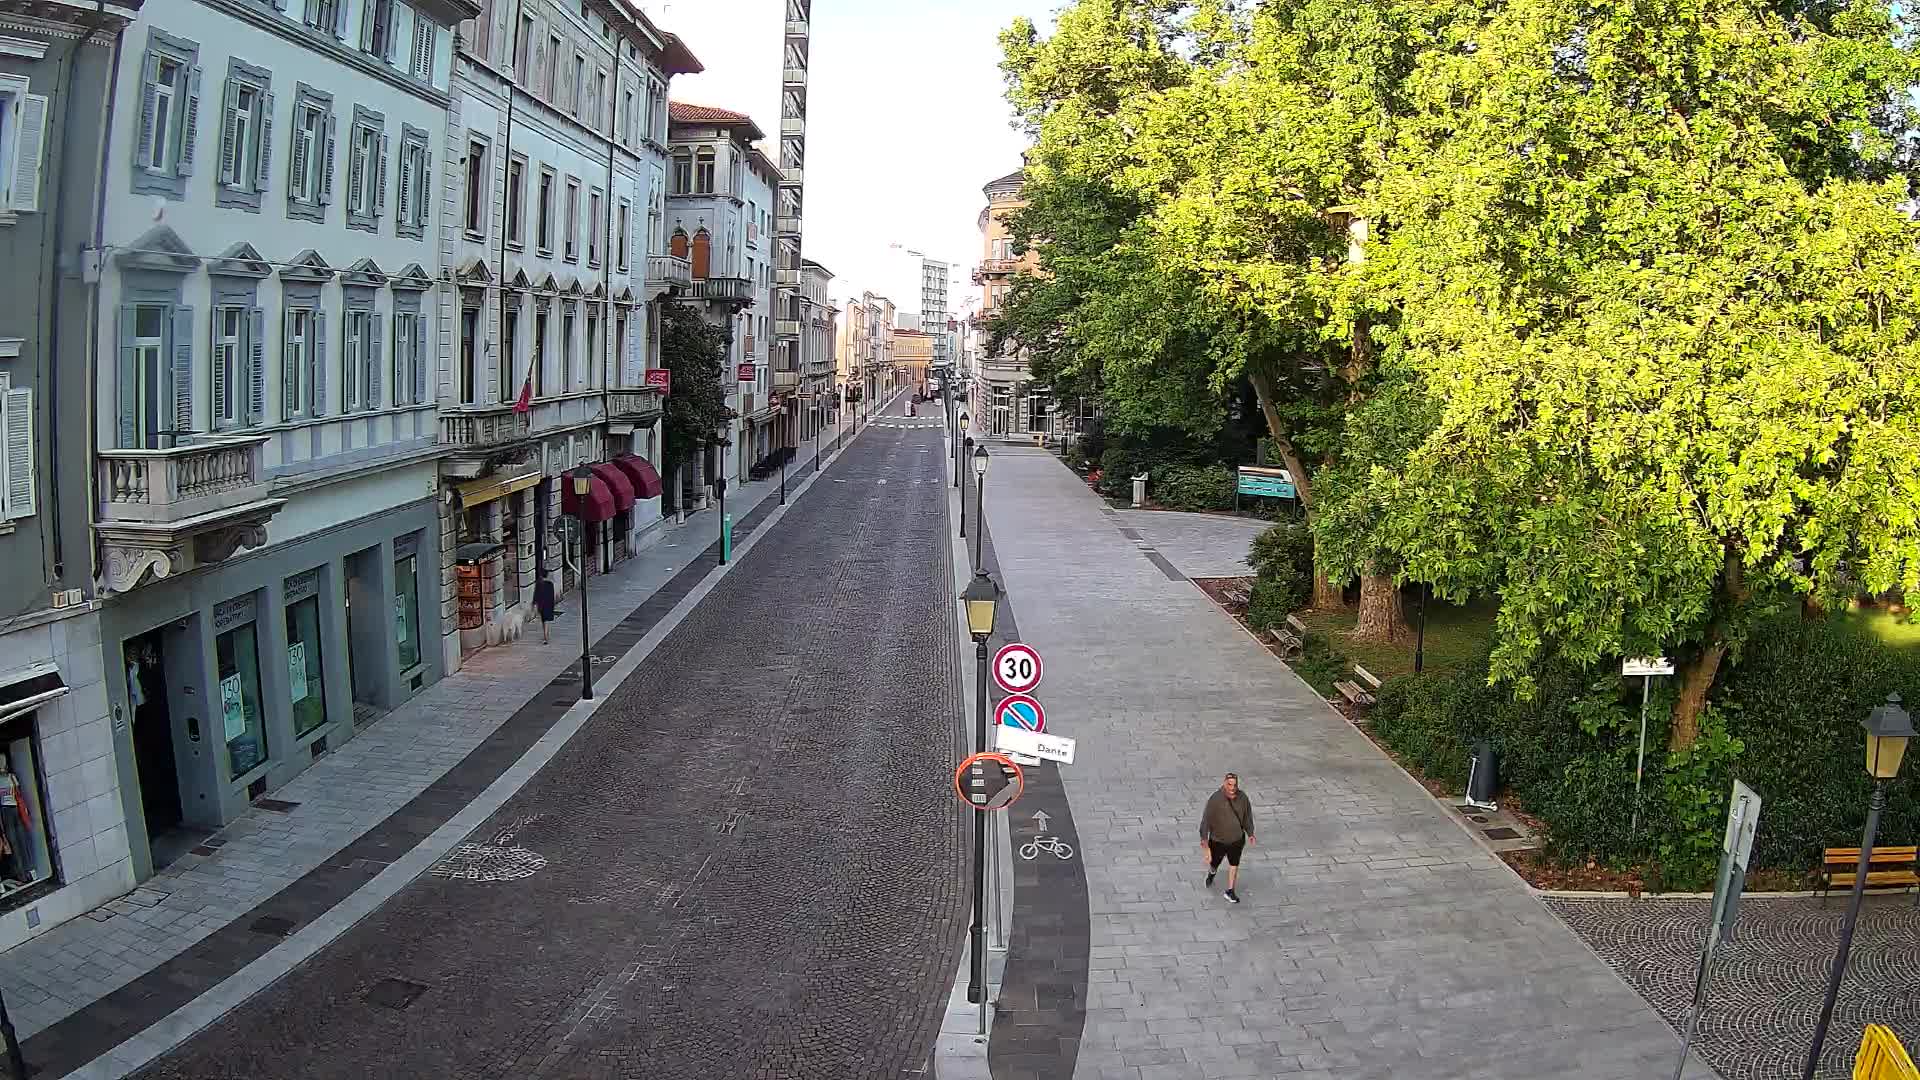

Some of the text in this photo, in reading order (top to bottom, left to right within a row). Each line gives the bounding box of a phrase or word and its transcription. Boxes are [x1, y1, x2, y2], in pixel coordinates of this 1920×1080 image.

[1005, 657, 1032, 679] 30
[222, 677, 240, 700] 130
[1038, 743, 1067, 756] Dante
